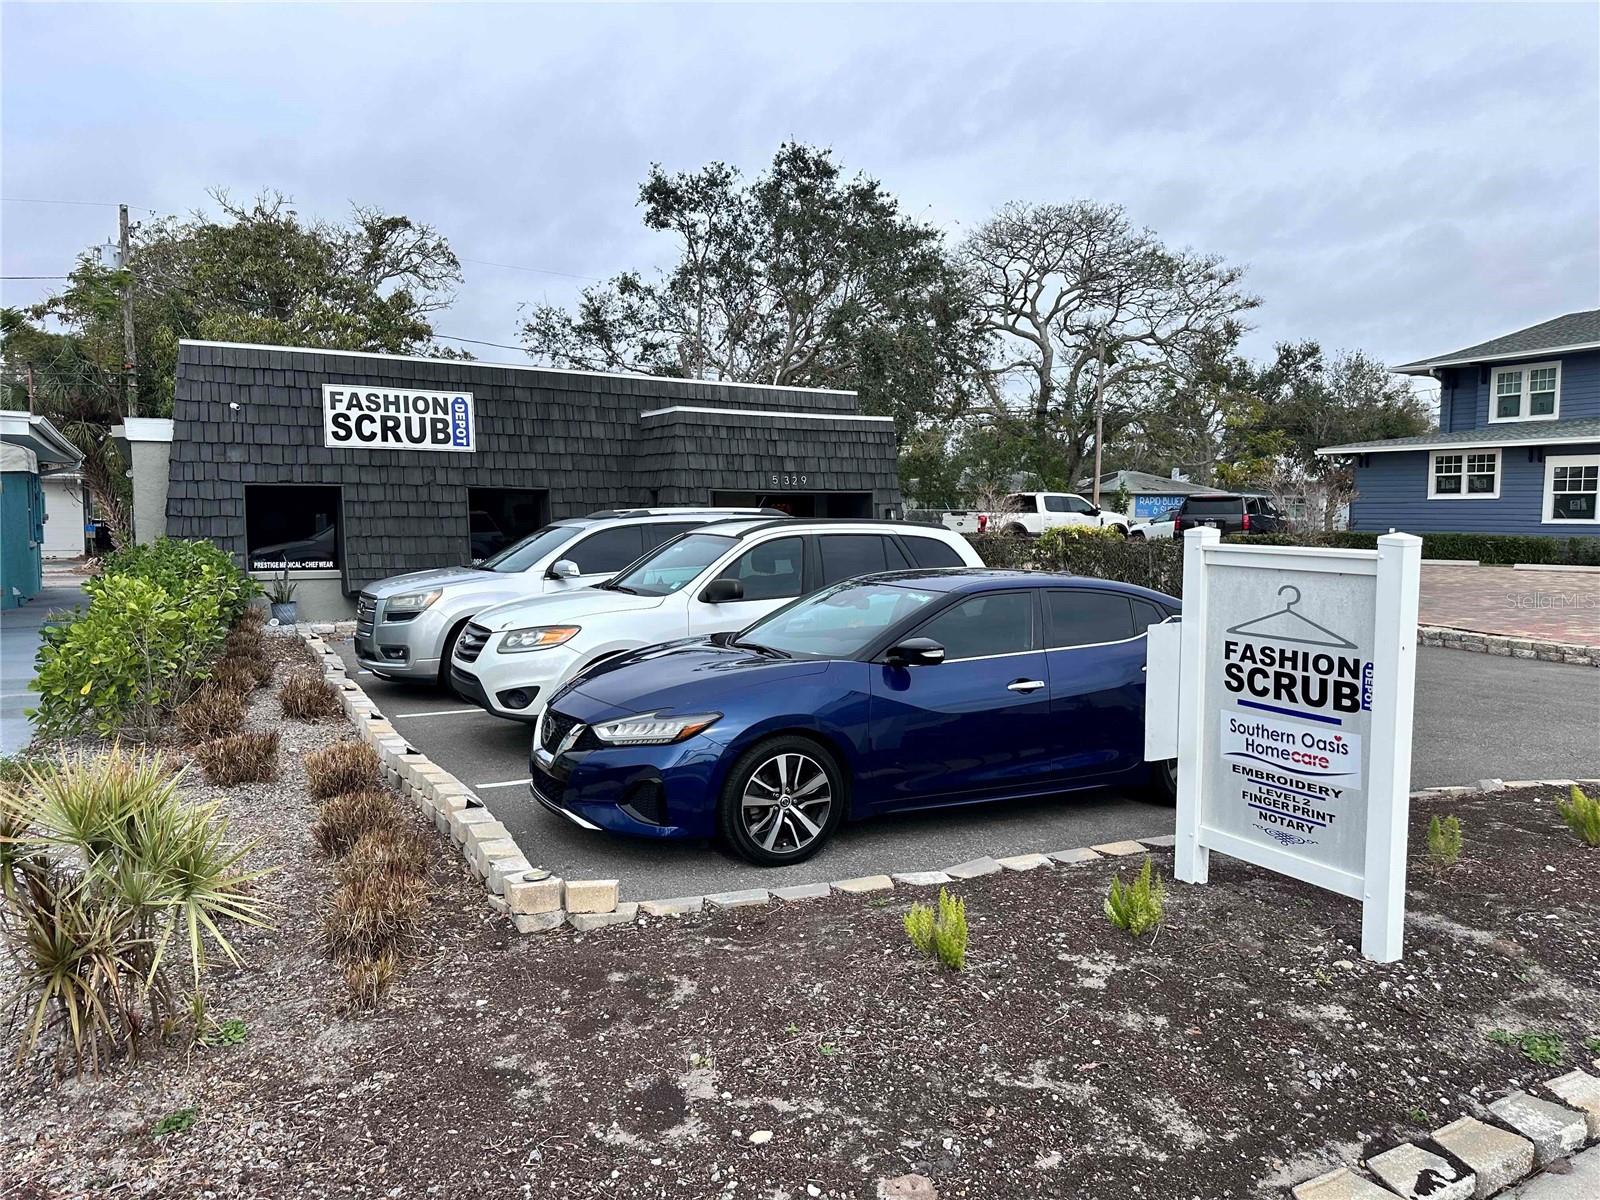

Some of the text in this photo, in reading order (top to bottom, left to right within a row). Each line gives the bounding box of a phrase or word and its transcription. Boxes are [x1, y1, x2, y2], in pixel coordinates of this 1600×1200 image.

[329, 391, 449, 415] FASHION
[331, 412, 451, 445] SCRUB
[454, 403, 467, 445] DEPOT
[1139, 496, 1160, 506] RAPID
[253, 561, 279, 569] PRESTIGE
[1224, 640, 1361, 680] FASHION
[1224, 662, 1361, 714] SCRUB
[1364, 668, 1374, 711] DEPOT
[1229, 718, 1349, 755] Southern Oasis
[1245, 737, 1330, 769] Homecare
[1232, 764, 1343, 799] EMBROIDERY
[1258, 786, 1311, 807] LEVEL 2
[1242, 790, 1336, 824] FINGER PRINT
[1258, 810, 1315, 834] NOTARY
